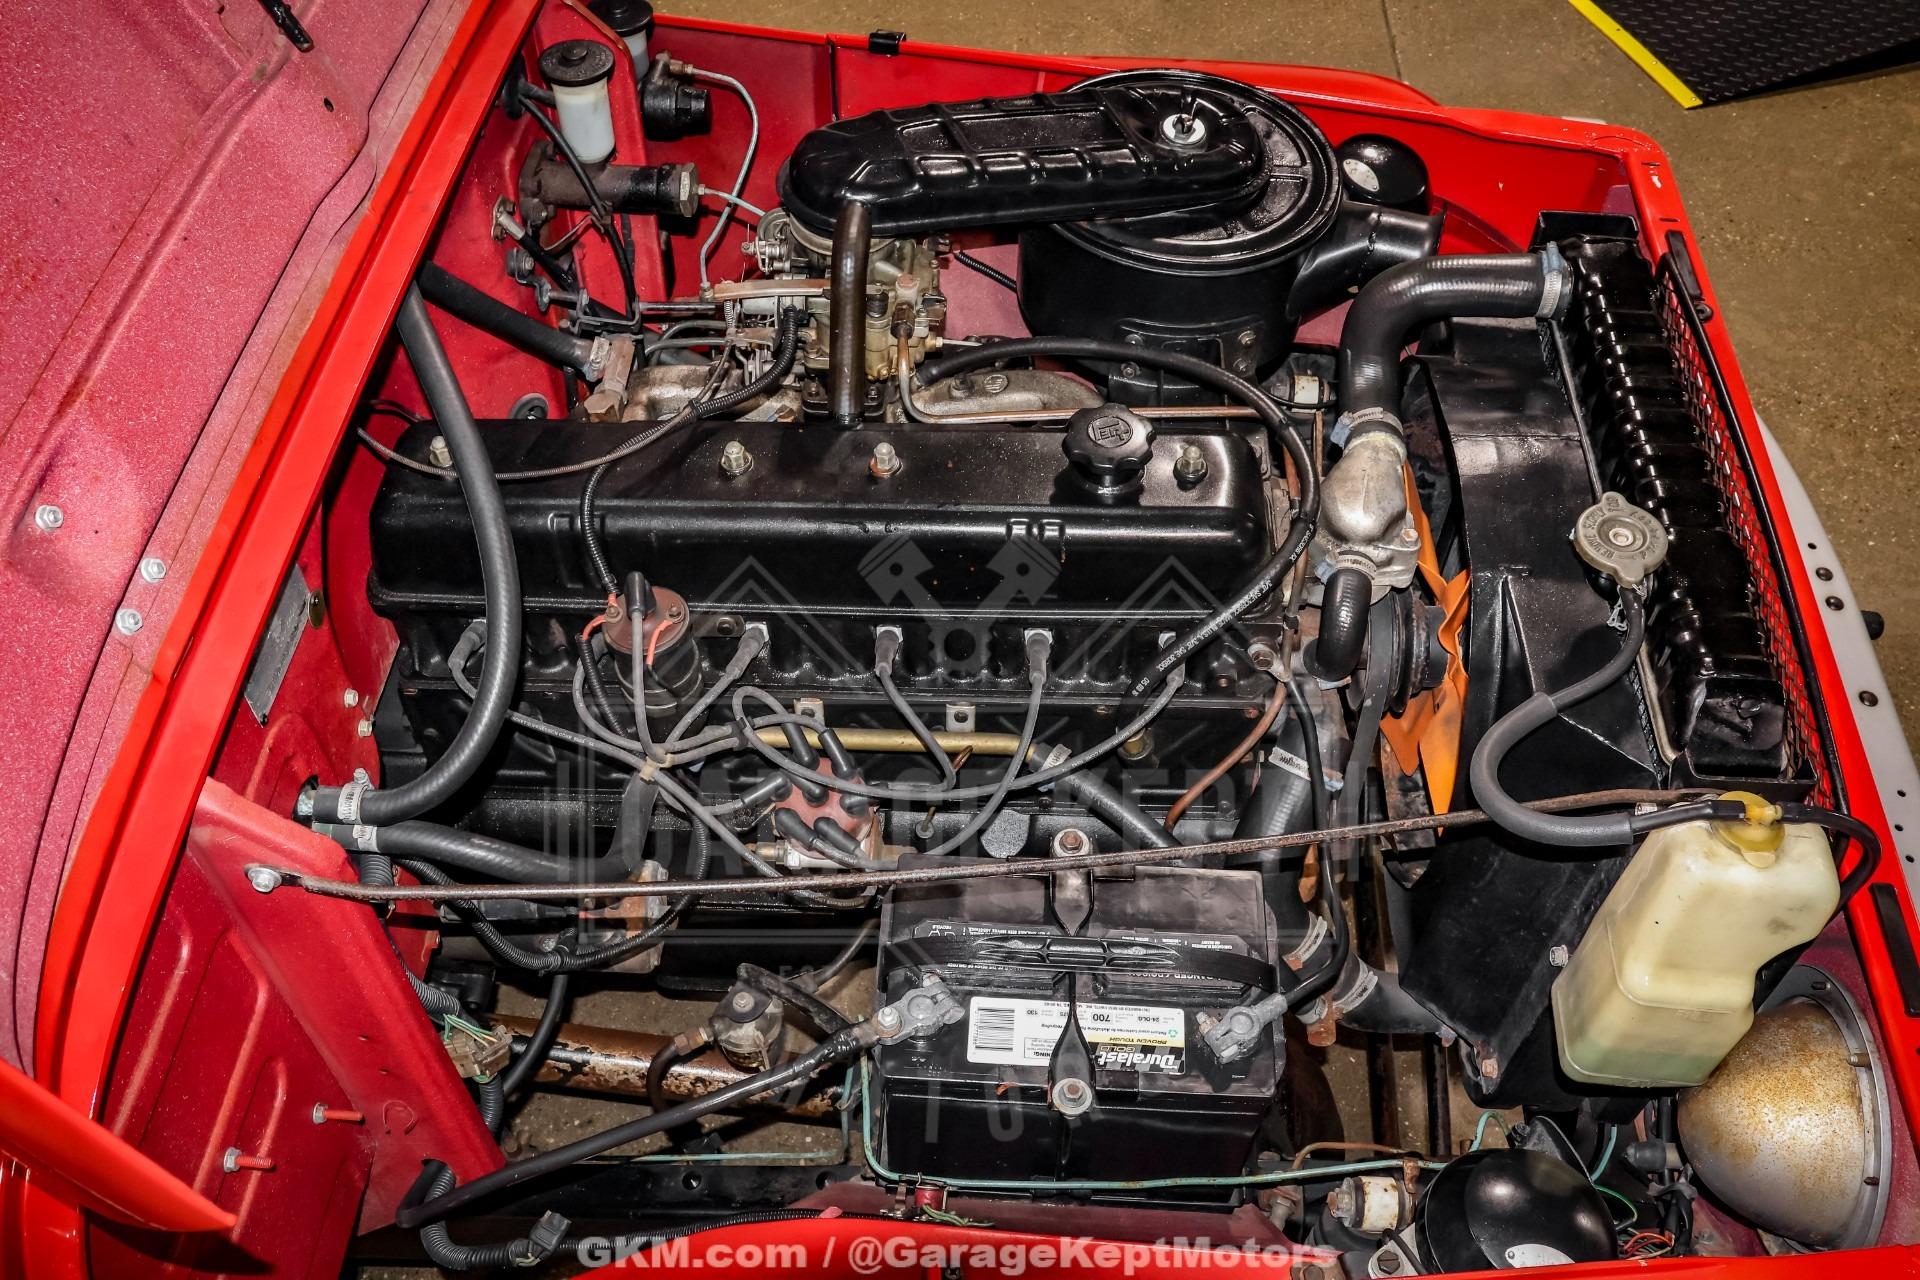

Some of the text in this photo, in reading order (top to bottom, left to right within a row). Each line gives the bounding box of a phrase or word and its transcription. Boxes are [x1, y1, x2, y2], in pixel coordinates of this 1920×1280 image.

[1093, 1013, 1111, 1022] 700
[1100, 1045, 1136, 1053] GOLD
[1097, 1052, 1178, 1069] Duralast
